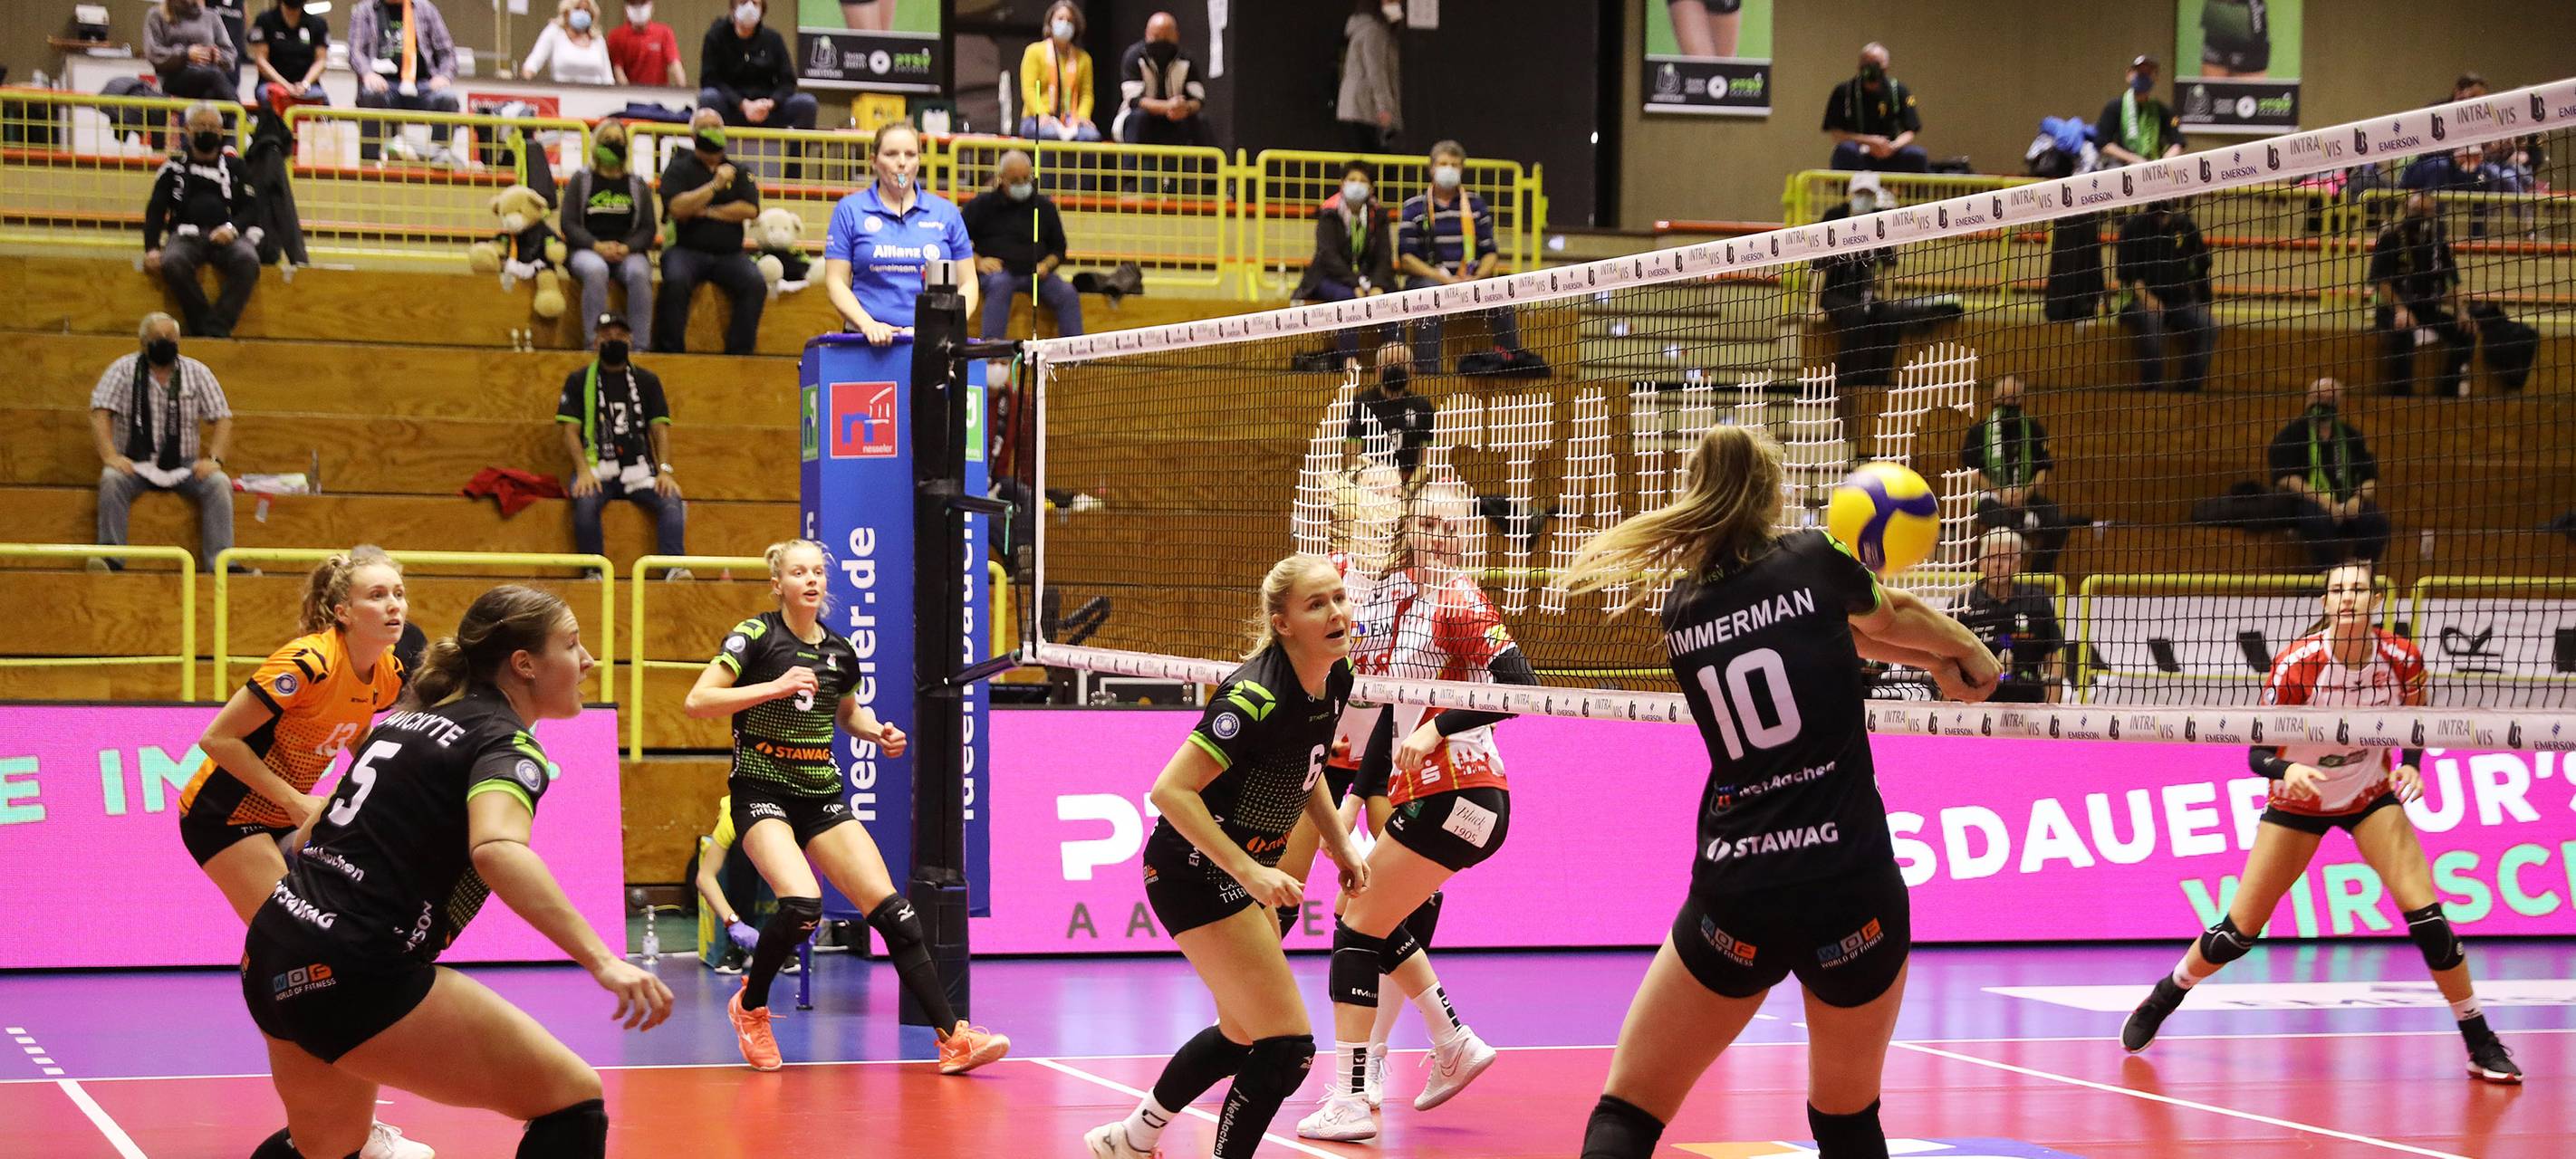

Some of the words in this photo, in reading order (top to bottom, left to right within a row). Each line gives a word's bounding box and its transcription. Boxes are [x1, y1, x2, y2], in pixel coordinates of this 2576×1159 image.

[2379, 136, 2420, 152] EMERSON
[2221, 166, 2257, 179] EMERSON
[2081, 192, 2113, 205] EMERSON
[1956, 215, 1985, 225] EMERSON
[1842, 235, 1869, 245] EMERSON
[873, 245, 921, 258] Allianz
[1741, 252, 1764, 262] EMERSON
[1648, 268, 1670, 277] EMERSON
[1563, 282, 1583, 291] EMERSON
[862, 444, 892, 454] nesseler
[1697, 647, 1802, 761] 10
[1945, 728, 1973, 736] EMERSON
[2068, 732, 2100, 740] EMERSON
[2205, 734, 2240, 743] EMERSON
[315, 723, 358, 757] 13
[2360, 737, 2398, 747] EMERSON
[775, 746, 830, 762] STAWAG
[1302, 743, 1325, 791] 6
[327, 740, 402, 827] 5
[1734, 822, 1839, 857] STAWAG
[1821, 955, 1848, 969] WORLD
[1860, 933, 1884, 955] FITNESS
[294, 986, 303, 995] OF
[304, 977, 337, 991] FITNESS
[1214, 1098, 1242, 1156] NetAachen
